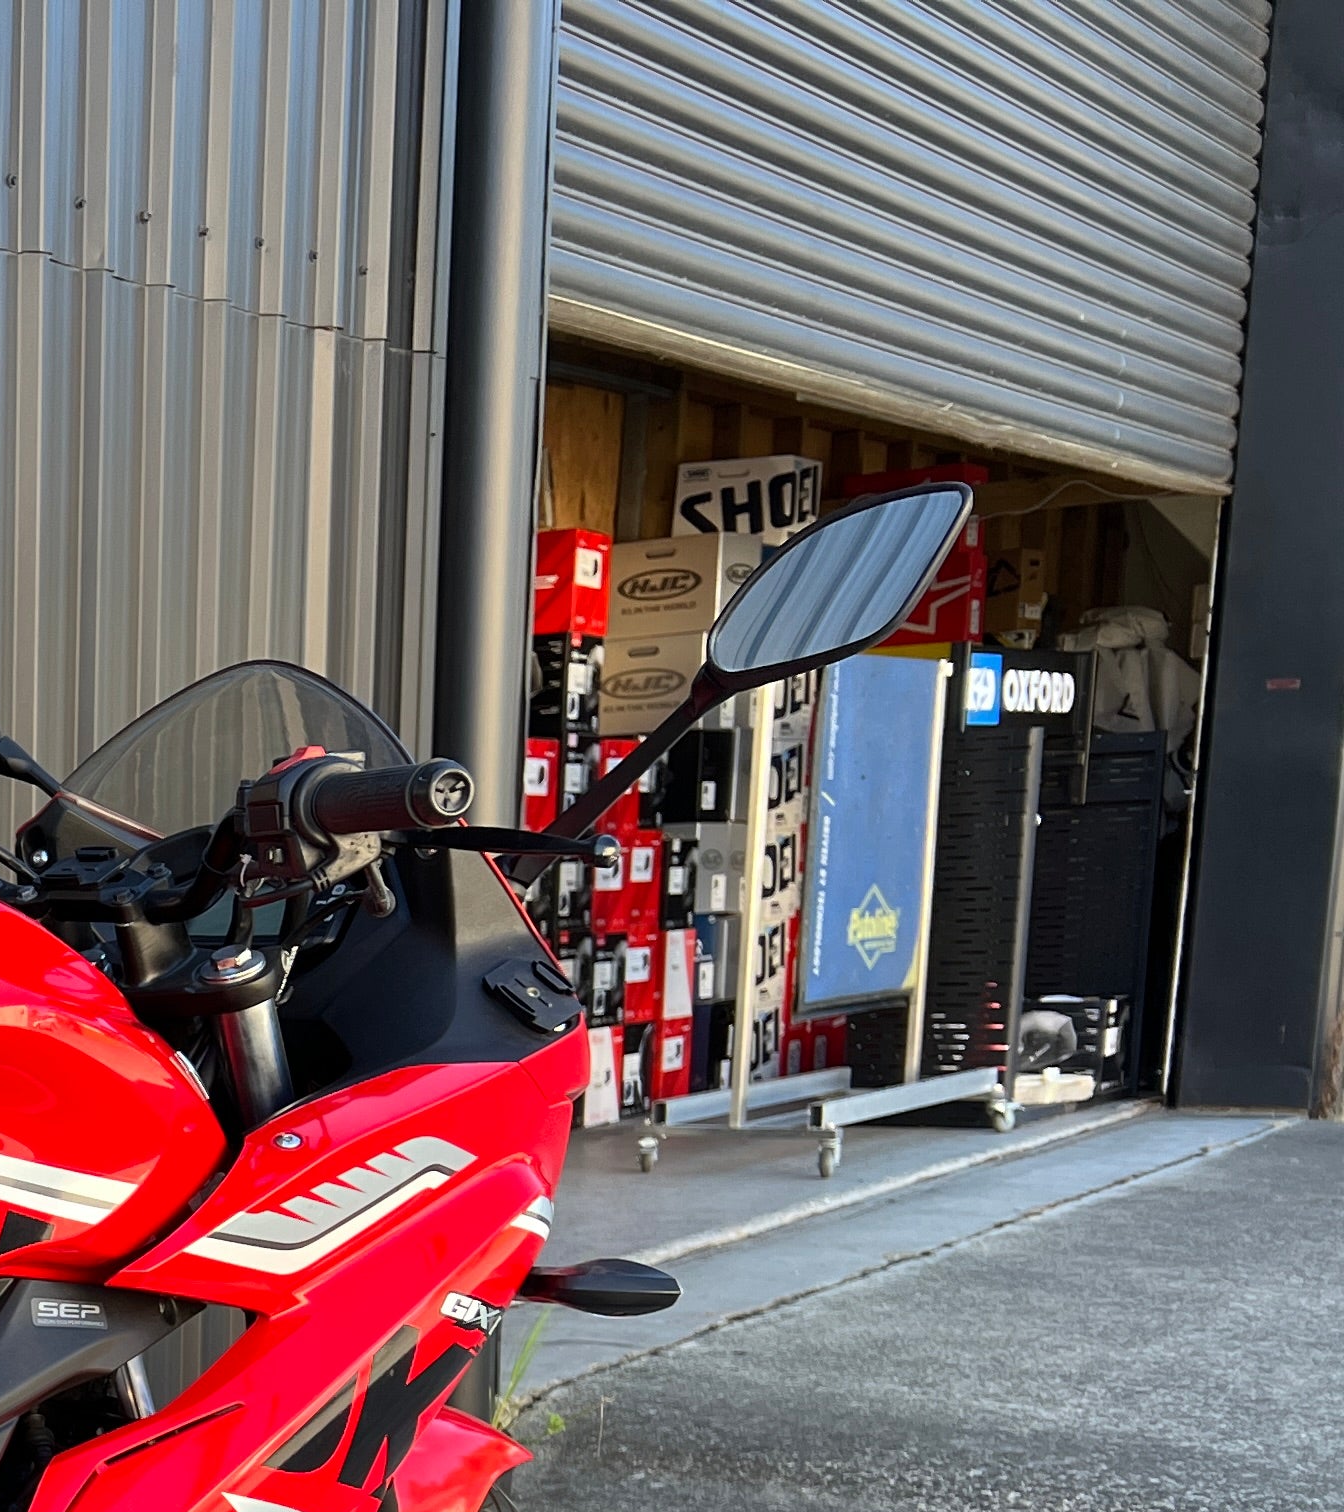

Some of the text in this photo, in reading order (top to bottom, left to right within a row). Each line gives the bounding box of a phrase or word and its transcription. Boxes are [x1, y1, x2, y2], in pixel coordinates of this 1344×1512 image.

[627, 573, 691, 595] HJC
[1002, 668, 1075, 713] OXFORD
[37, 1301, 100, 1319] SEP
